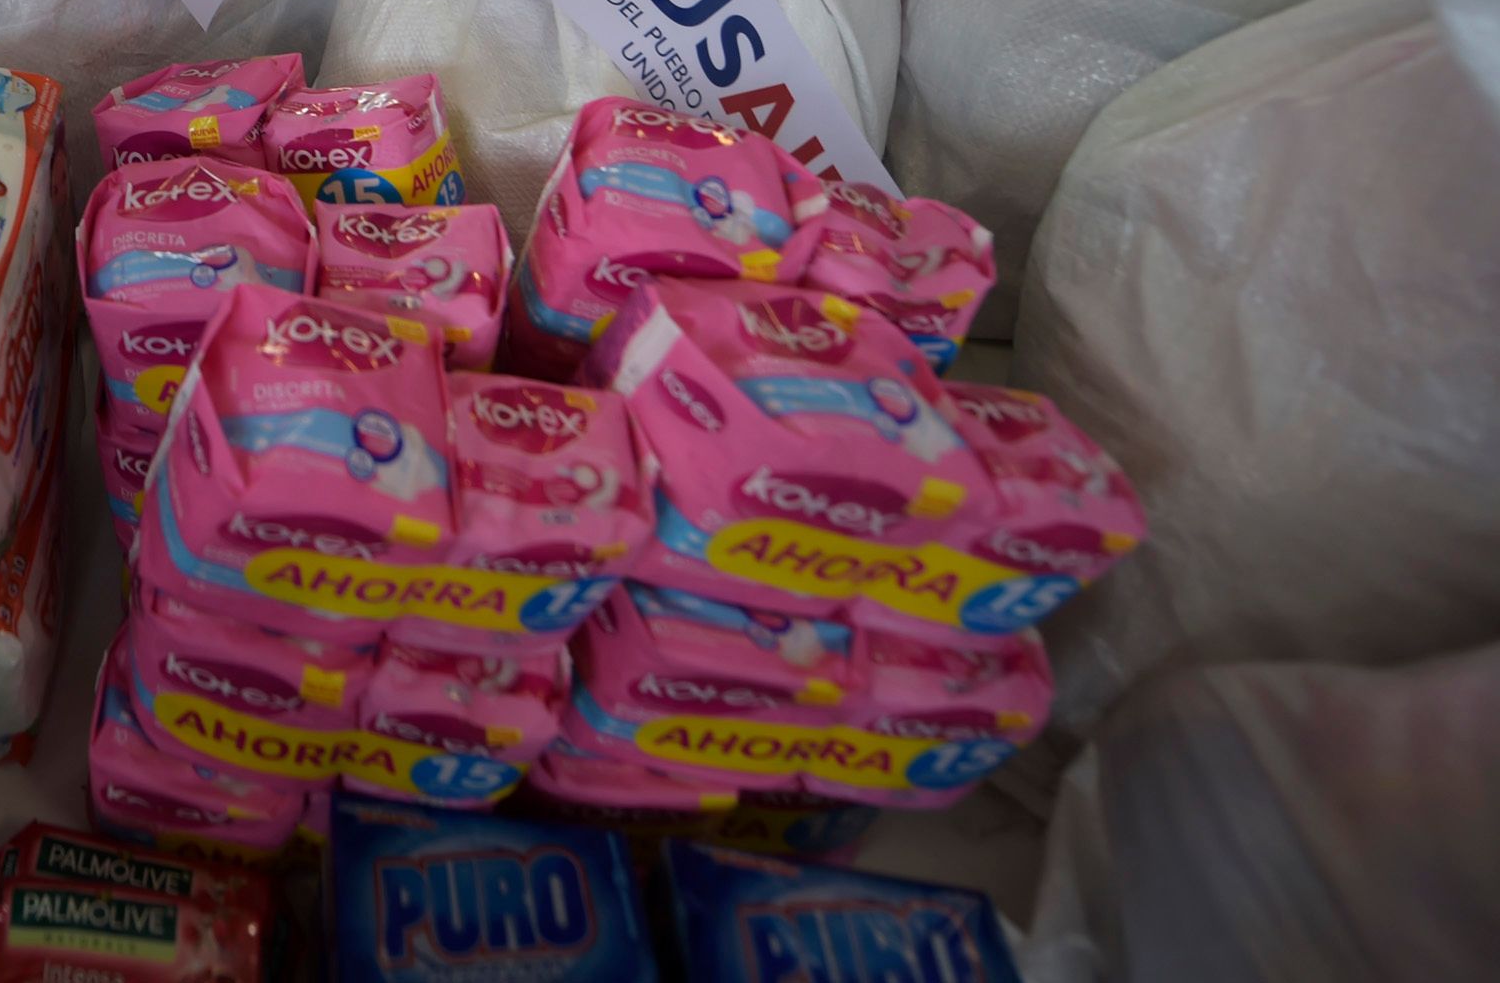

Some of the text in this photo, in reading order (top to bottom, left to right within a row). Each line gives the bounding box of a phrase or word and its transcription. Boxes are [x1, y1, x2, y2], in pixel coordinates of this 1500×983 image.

[620, 40, 677, 111] UNIDO
[644, 25, 704, 112] PUEBLO
[613, 108, 743, 143] kotex
[278, 144, 372, 170] kotex
[124, 180, 238, 211] kotex
[323, 178, 386, 205] 15
[112, 230, 187, 248] DISCRETA
[338, 212, 444, 245] kotex
[122, 330, 199, 357] kot
[265, 315, 400, 365] kotex
[471, 391, 586, 438] kotex
[740, 464, 890, 537] kotex
[228, 514, 375, 561] kotex
[265, 562, 508, 615] AHORRA
[984, 578, 1071, 613] 15
[166, 653, 304, 712] kotex
[173, 709, 503, 789] AHORRA 15
[654, 725, 1001, 775] AHORRA 15
[49, 842, 182, 897] PALMOLIVE
[22, 891, 166, 936] PALMOLIVE
[376, 848, 595, 962] PURO
